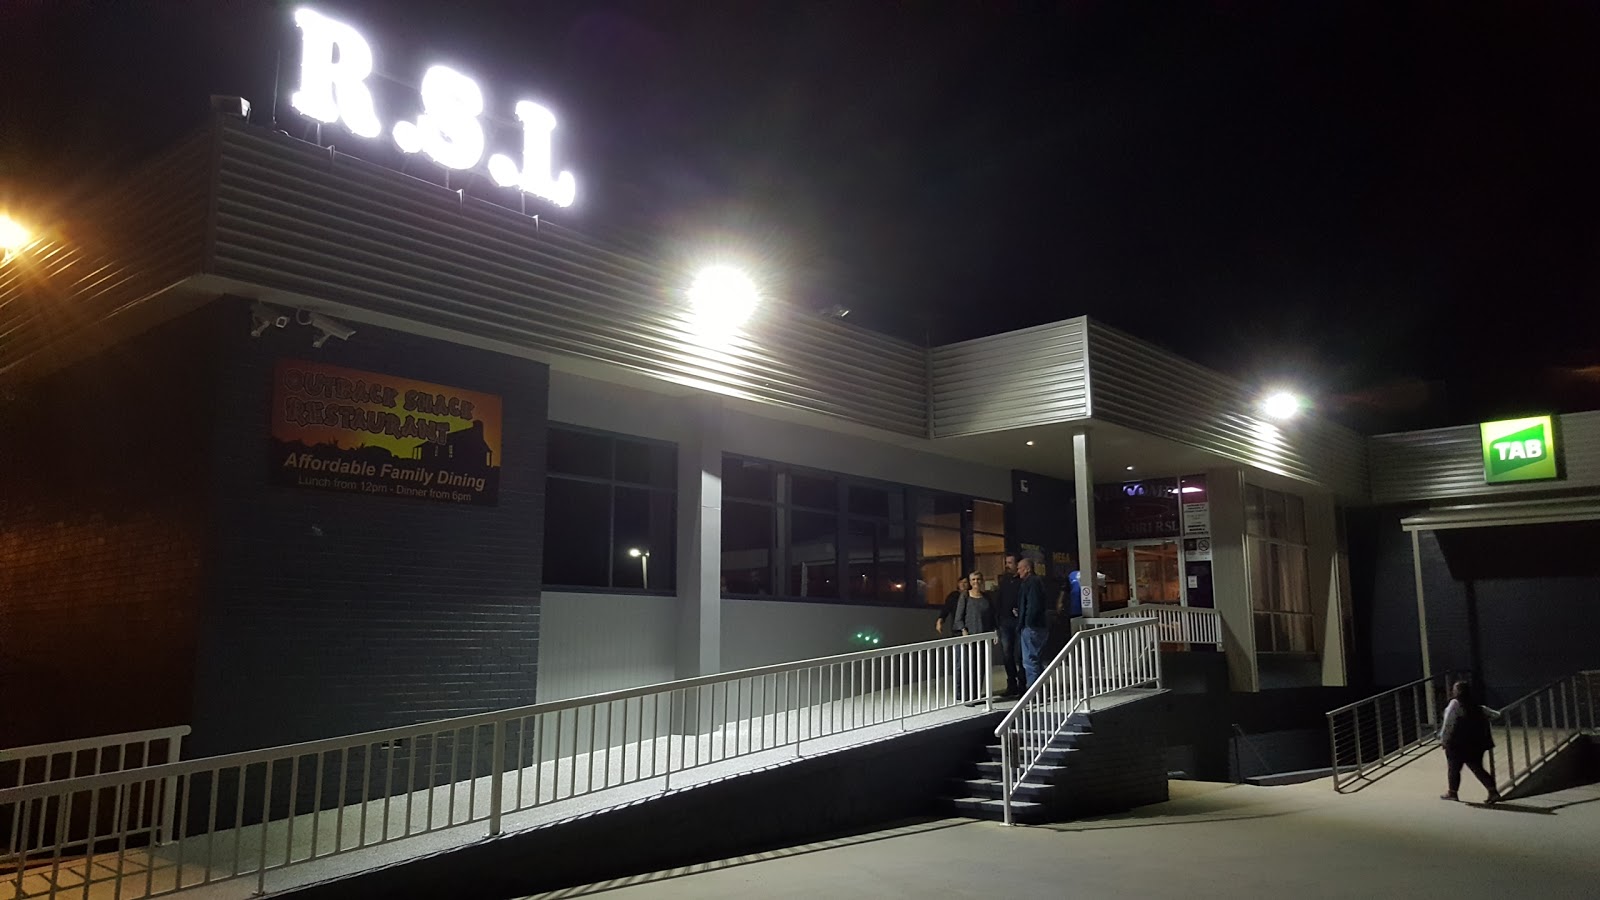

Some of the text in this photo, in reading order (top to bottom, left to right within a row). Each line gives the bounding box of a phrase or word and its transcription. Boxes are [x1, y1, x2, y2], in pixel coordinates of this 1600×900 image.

[284, 368, 476, 420] OUTBACK SHACK
[284, 396, 451, 446] RESTAURANT
[1493, 438, 1542, 460] TAB
[284, 452, 486, 492] Affordable Family Dining
[298, 476, 331, 488] Lunch
[333, 478, 357, 490] from
[361, 481, 388, 494] 12pm
[396, 485, 427, 498] Dinner
[429, 488, 450, 500] from
[452, 491, 472, 503] 6pm
